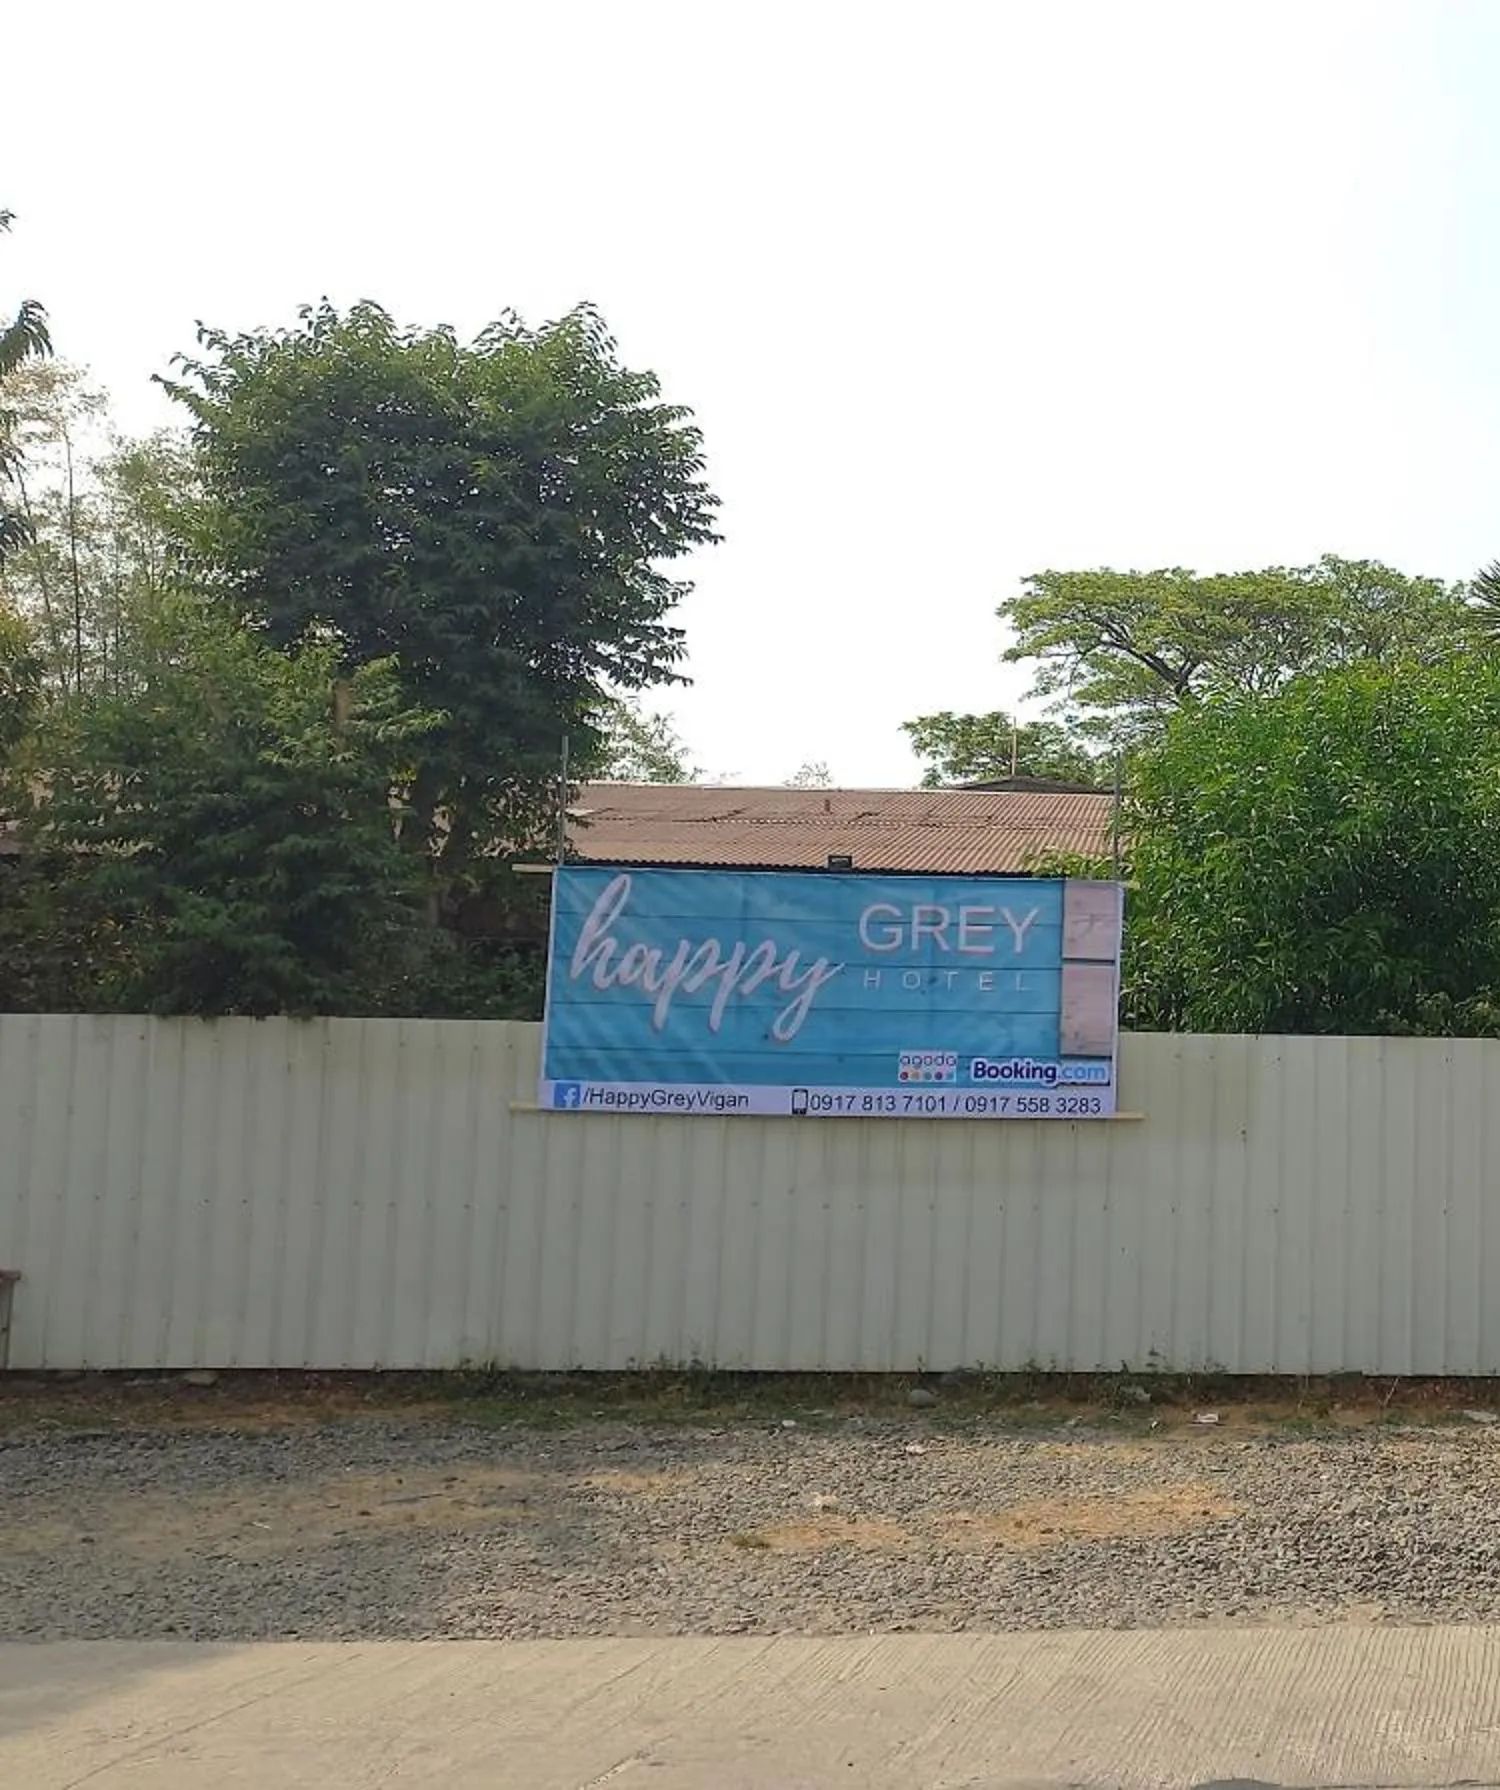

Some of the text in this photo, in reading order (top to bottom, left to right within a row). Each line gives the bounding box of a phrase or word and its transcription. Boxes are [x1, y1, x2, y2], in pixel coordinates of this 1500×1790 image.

[859, 903, 1039, 954] GREY
[570, 874, 845, 1041] happy
[863, 969, 1033, 991] HOTEL
[900, 1053, 956, 1068] agoda
[972, 1061, 1106, 1082] Booking.com
[809, 1094, 855, 1110] 0917
[861, 1095, 896, 1111] 813
[903, 1095, 947, 1111] 7101
[965, 1096, 1009, 1112] 0917
[1017, 1097, 1050, 1113] 558
[1056, 1097, 1101, 1114] 3283
